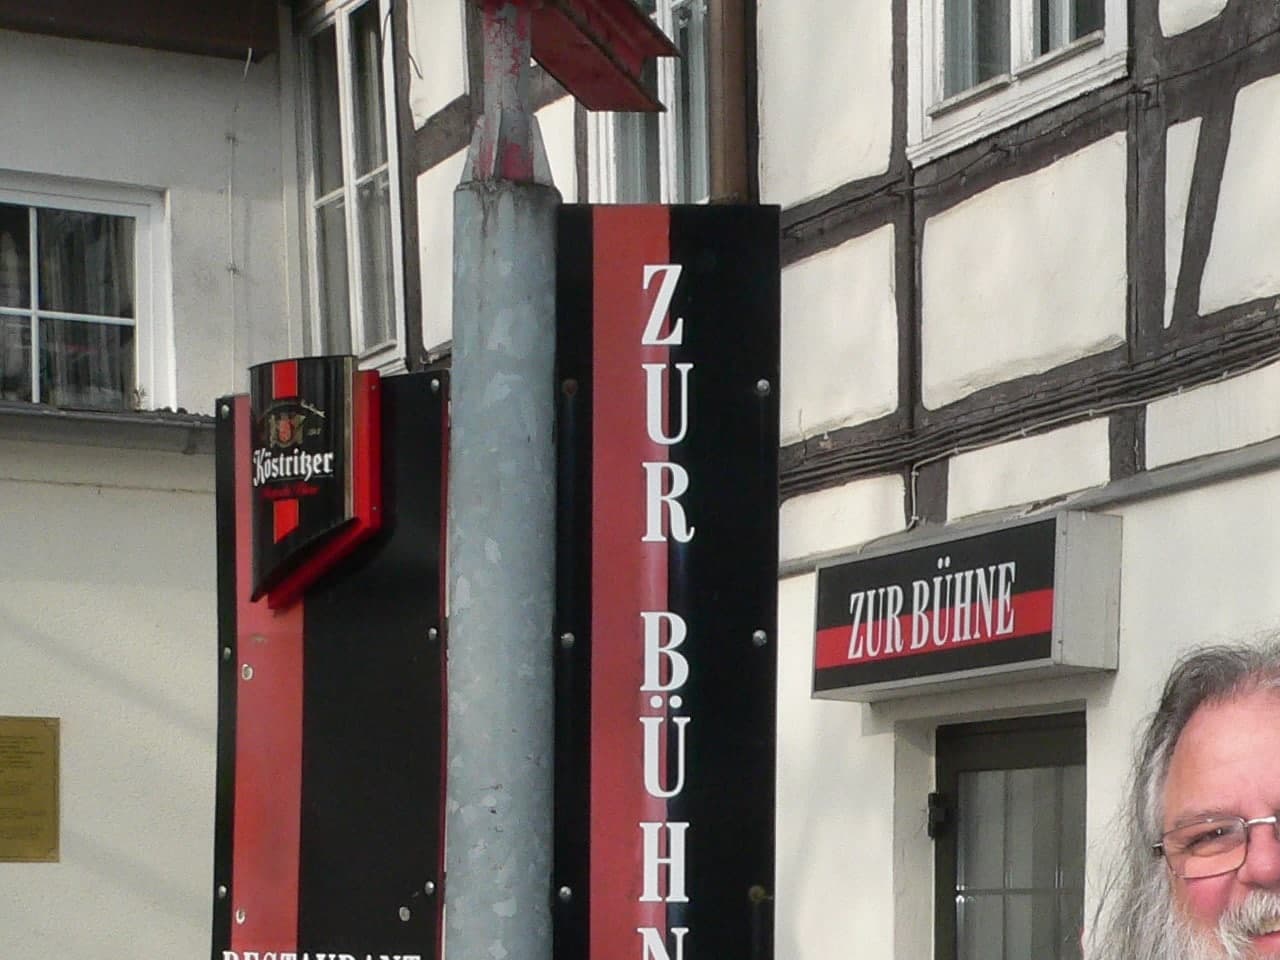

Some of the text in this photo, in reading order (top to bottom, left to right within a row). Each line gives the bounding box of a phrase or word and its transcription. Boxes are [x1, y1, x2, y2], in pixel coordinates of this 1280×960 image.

[641, 264, 695, 543] ZUR
[253, 447, 334, 487] Köstritzer
[848, 555, 1017, 660] ZUR BÜHNE
